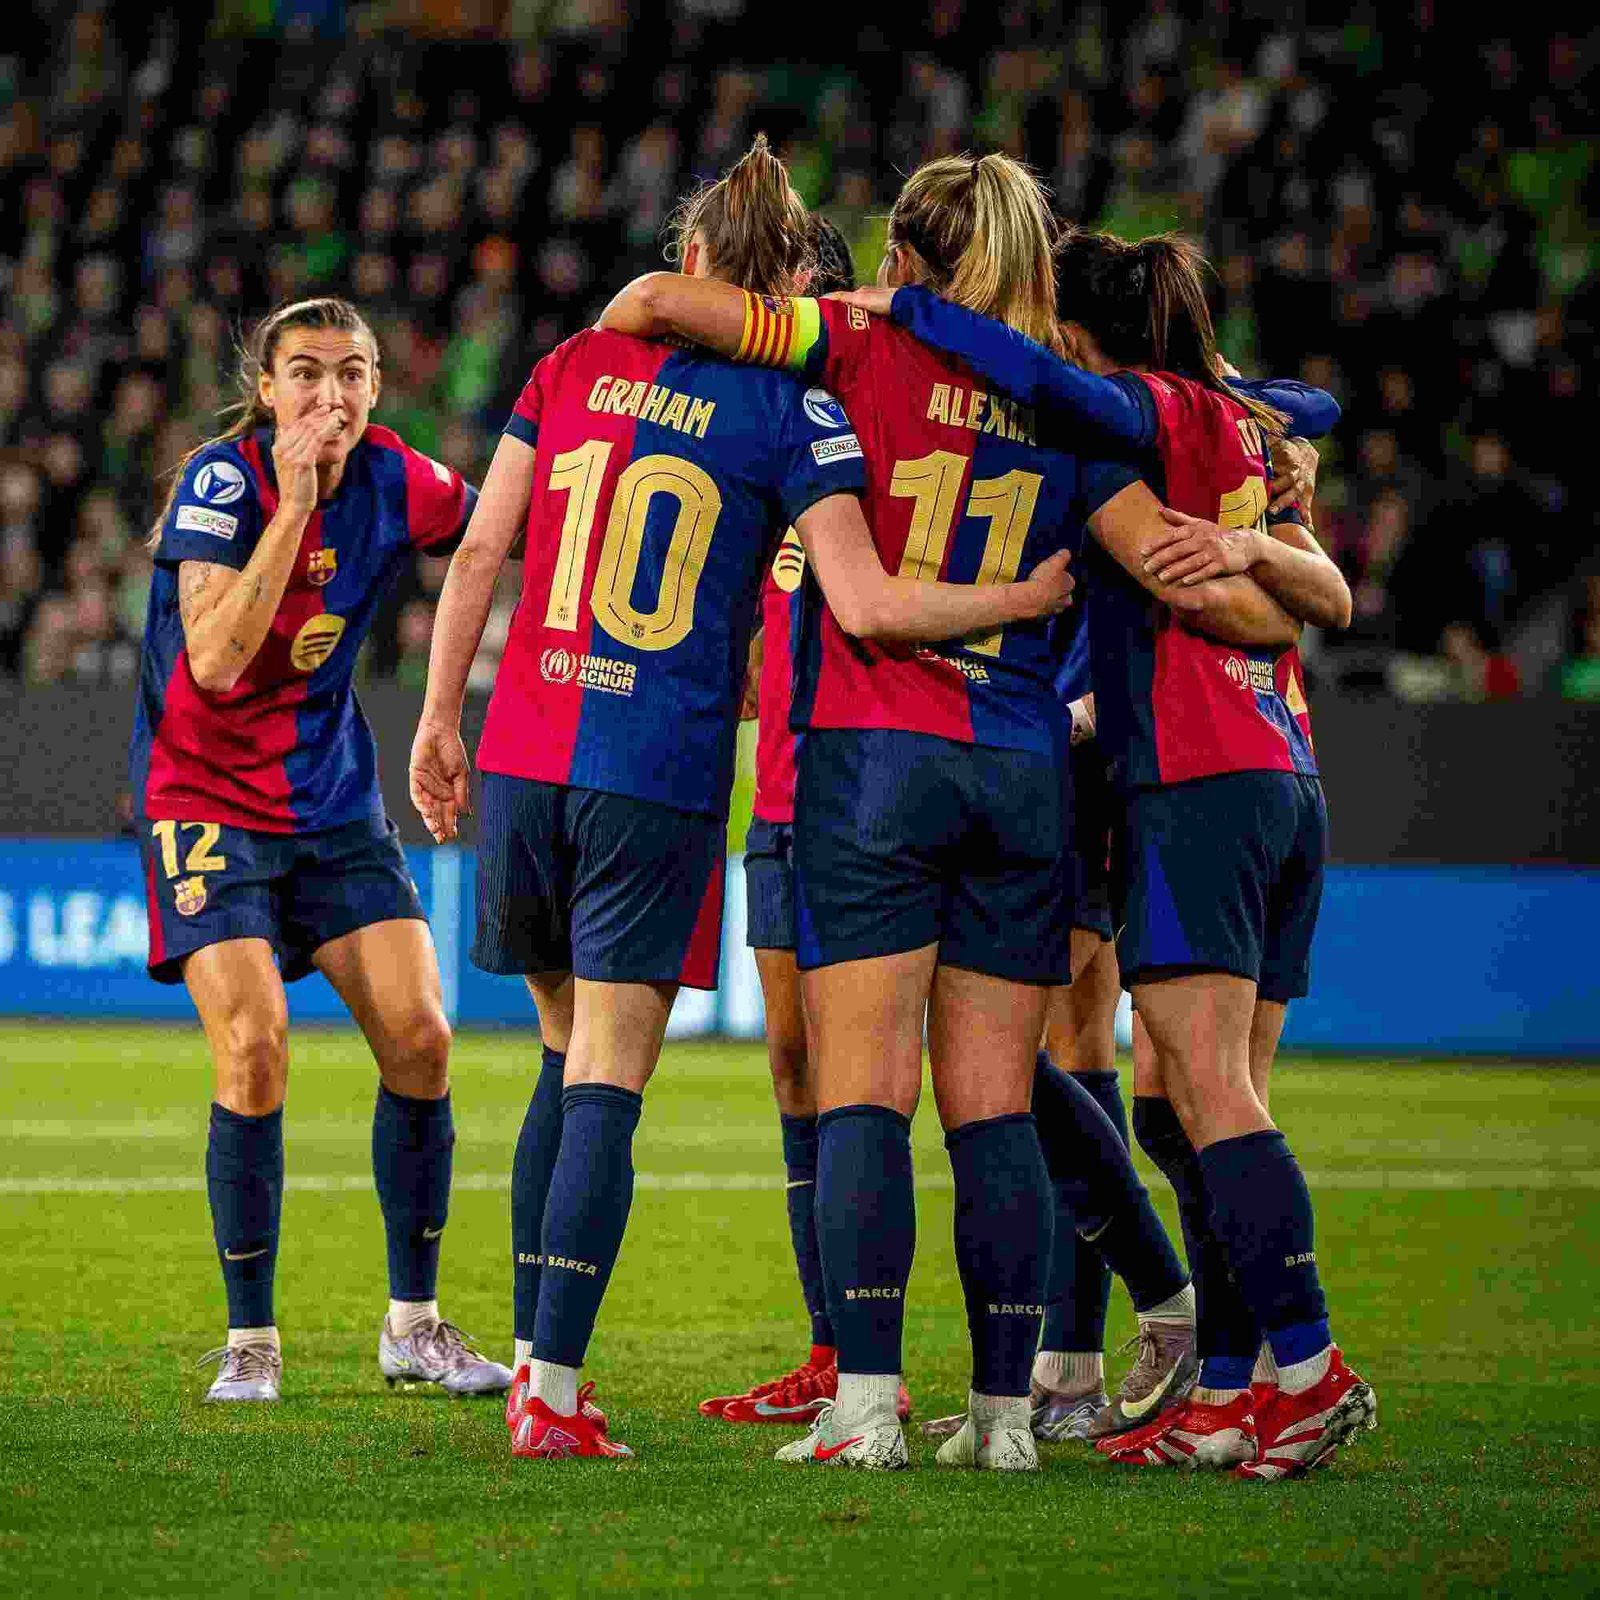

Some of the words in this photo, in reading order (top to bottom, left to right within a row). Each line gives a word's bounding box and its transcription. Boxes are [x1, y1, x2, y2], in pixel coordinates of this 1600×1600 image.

[587, 375, 716, 439] GRAHAM
[543, 439, 723, 651] 10
[890, 449, 1045, 657] 11
[575, 667, 635, 692] ACNUR
[580, 653, 638, 679] UNHCR
[152, 819, 226, 879] 12
